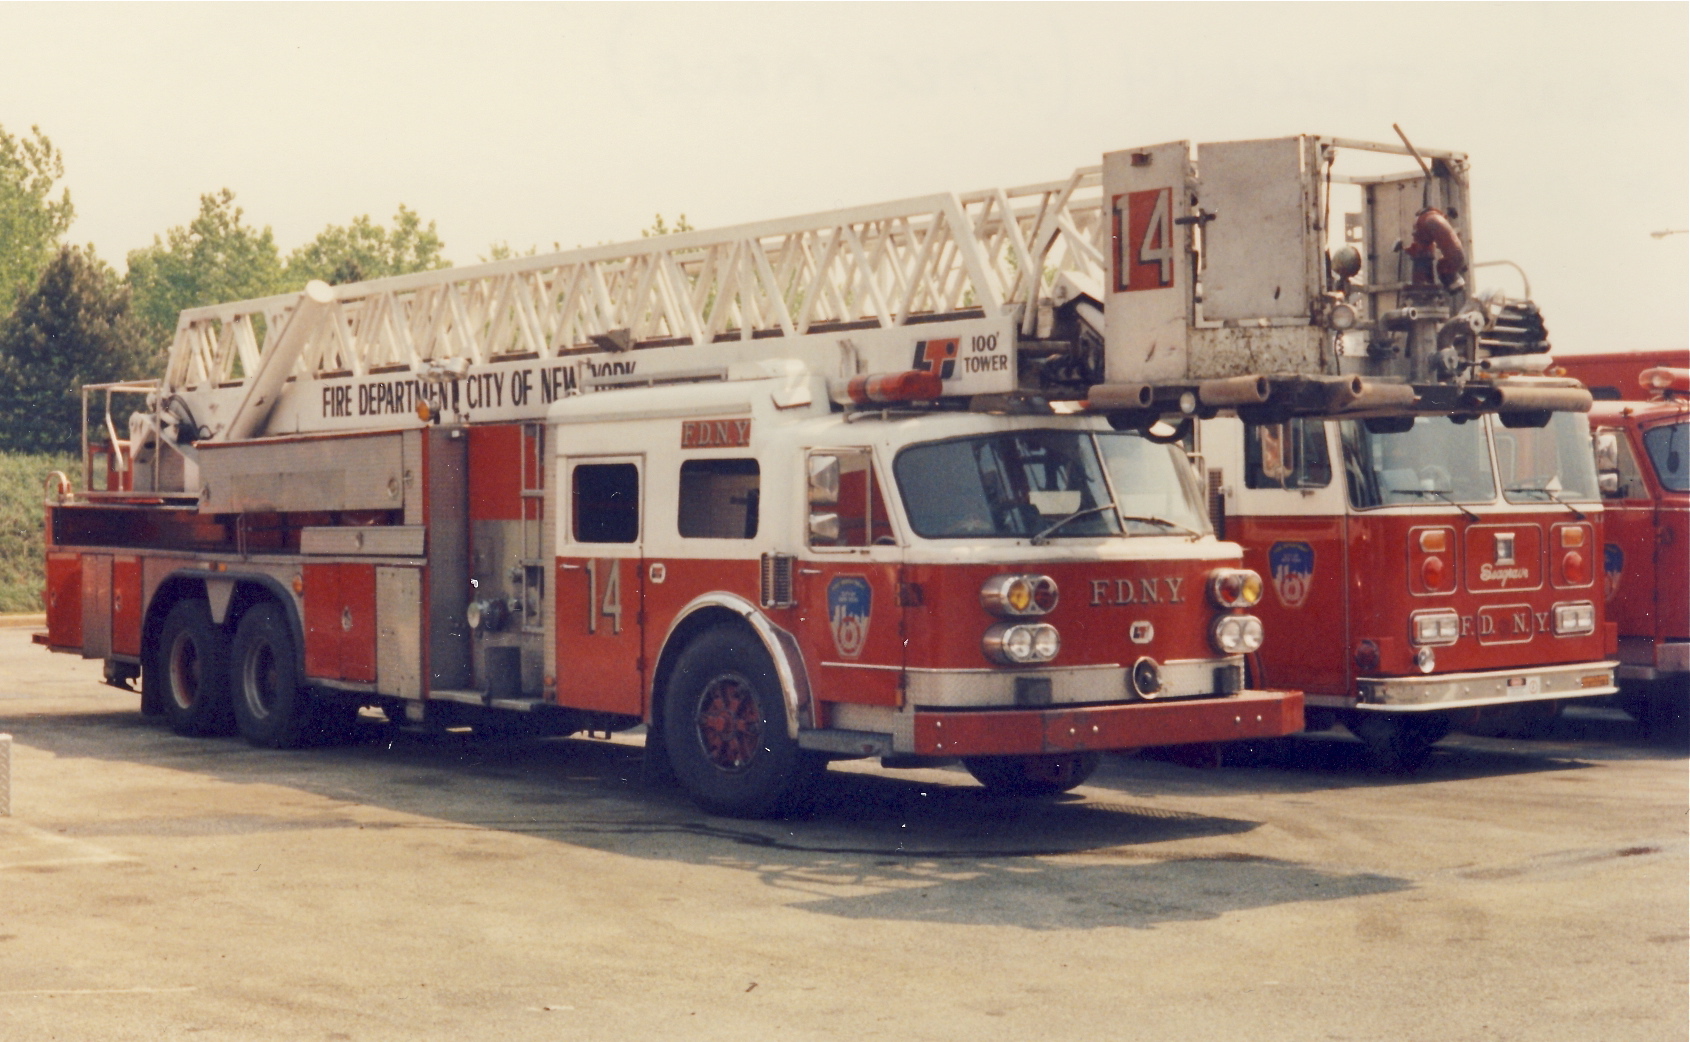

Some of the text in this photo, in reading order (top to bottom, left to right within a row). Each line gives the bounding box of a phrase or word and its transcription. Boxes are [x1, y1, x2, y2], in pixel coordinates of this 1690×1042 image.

[1113, 189, 1173, 290] 14
[964, 354, 1008, 373] TOWER
[322, 384, 352, 418] FIRE
[358, 378, 459, 416] DEPARTMEN
[466, 371, 504, 410] CITY
[511, 368, 533, 407] OF
[541, 365, 578, 404] NEW
[586, 558, 621, 634] 14
[1089, 578, 1185, 606] F.D.N.Y.
